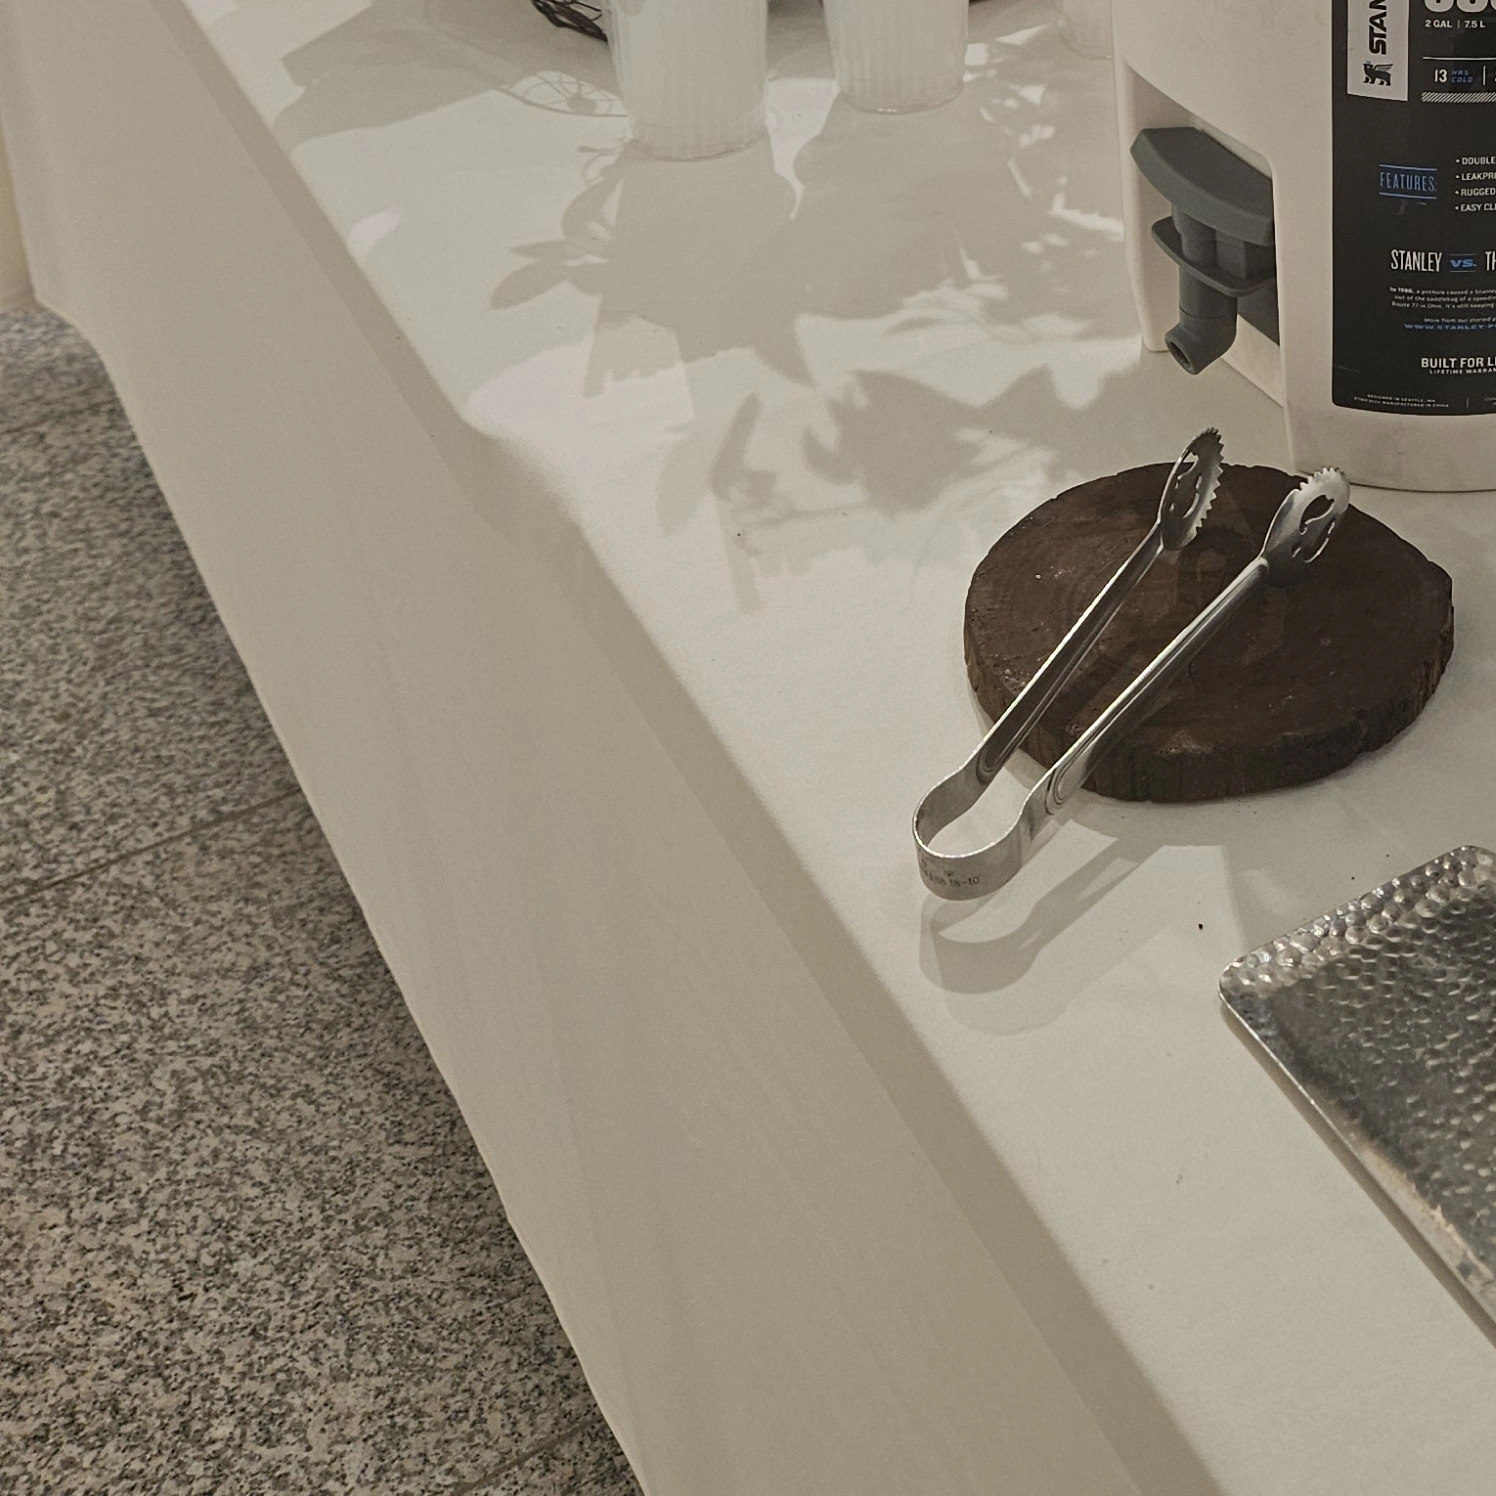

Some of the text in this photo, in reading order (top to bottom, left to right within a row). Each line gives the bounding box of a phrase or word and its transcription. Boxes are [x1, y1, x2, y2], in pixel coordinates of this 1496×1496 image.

[1425, 20, 1485, 28] 2 GAL 7.5 L
[1434, 69, 1448, 82] 13
[1461, 187, 1496, 197] RUGGED
[1460, 203, 1482, 212] EASY
[1391, 248, 1442, 272] STANLEY
[1421, 357, 1457, 368] BUILT
[1460, 357, 1484, 368] FOR
